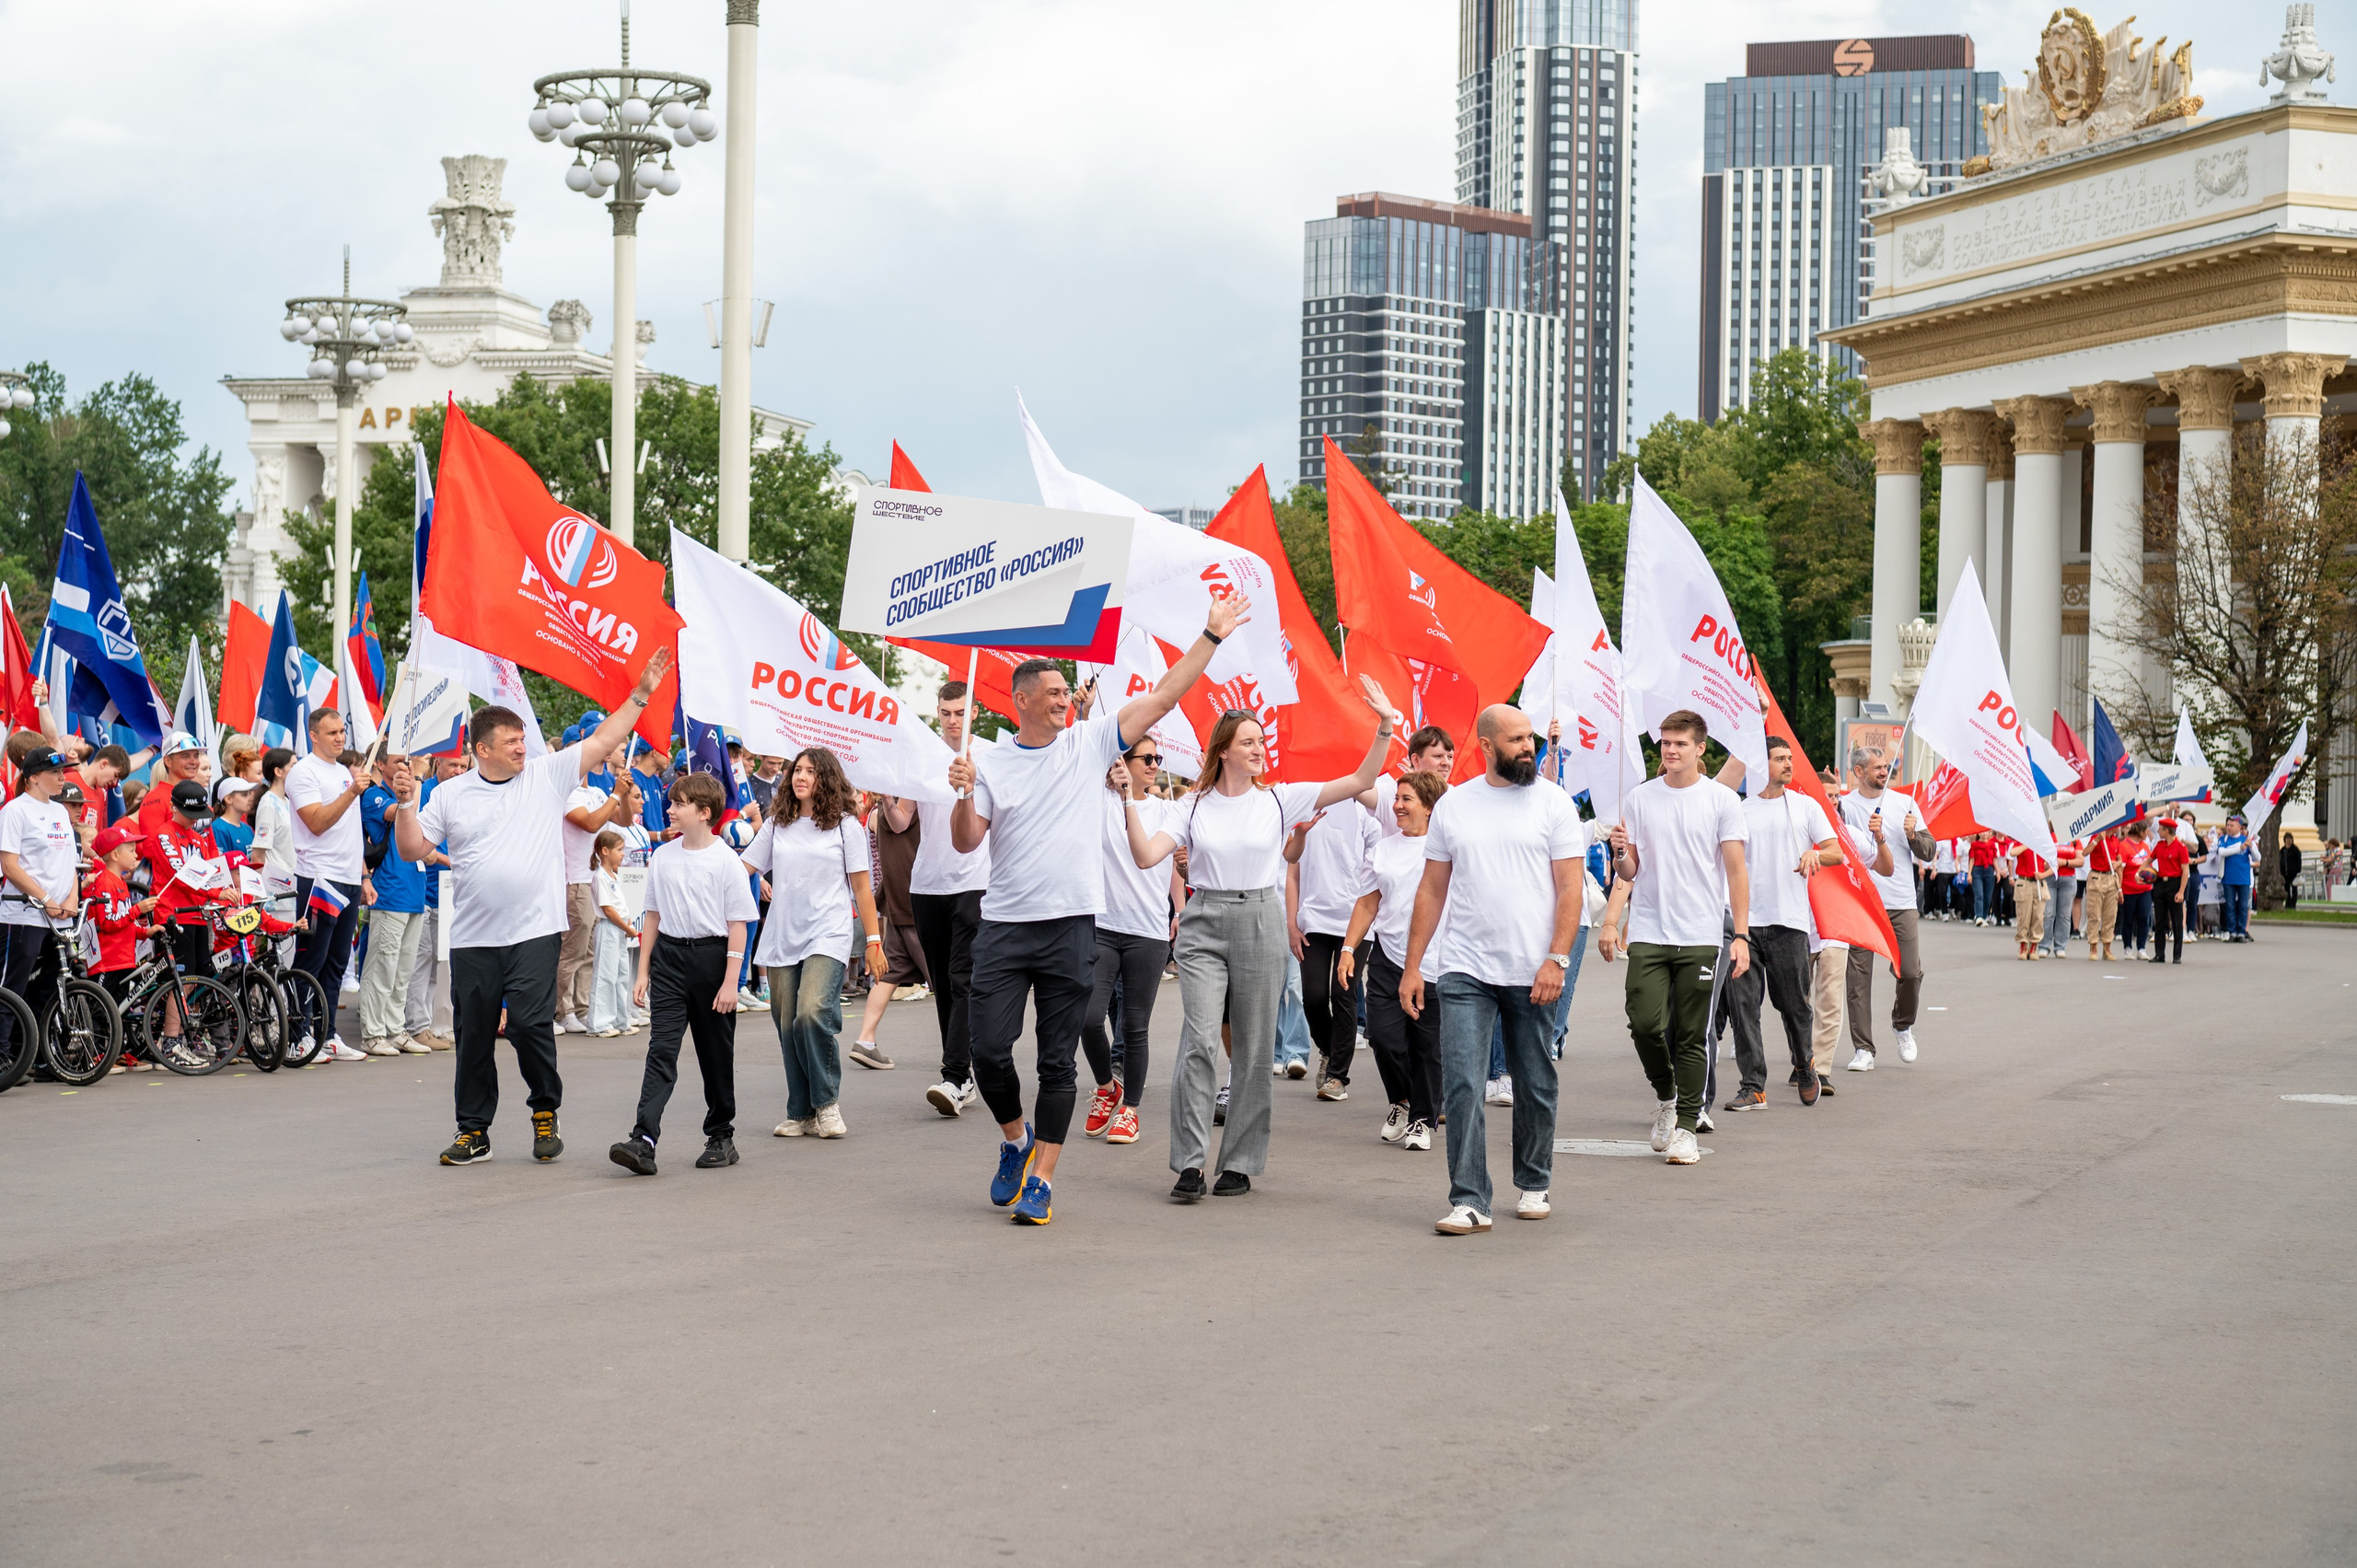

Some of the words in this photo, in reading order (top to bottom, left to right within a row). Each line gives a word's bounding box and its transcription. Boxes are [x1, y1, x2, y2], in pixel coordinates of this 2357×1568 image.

[1984, 168, 2146, 226] РОССИЙСКАЯ
[1953, 215, 2042, 251] СОВЕТСКАЯ
[2049, 179, 2186, 228] ФЕДЕРАТИВНАЯ
[1953, 224, 2087, 270] СОЦИАЛИСТИЧЕСКАЯ
[2096, 200, 2188, 237] РЕСПУБЛИКА
[872, 510, 925, 521] ШЕСТВИЕ
[886, 567, 997, 627] СООБЩЕСТВО
[1000, 536, 1085, 582] «РОССИЯ»
[889, 540, 997, 599] СПОРТИВНОЕ
[520, 554, 639, 656] РОССИЯ
[535, 630, 576, 654] ОСНОВАНО
[1681, 653, 1724, 680] ОБЩЕРОССИЙСКАЯ
[403, 678, 449, 729] ВЛОСИПЕДНЫЙ
[751, 661, 900, 726] РОССИЯ
[1207, 691, 1225, 718] ОСНОВ
[1593, 692, 1620, 719] ОСНОВАНО
[1691, 690, 1724, 714] ОСНОВАНО
[750, 699, 803, 721] ОБЩЕРОССИЙСКАЯ
[804, 717, 849, 733] ОБЩЕСТВЕННАЯ
[850, 728, 892, 744] ОРГАНИЗАЦИЯ
[778, 715, 861, 744] ФИЗКУЛЬТУРНО-СПОРТИВНОЕ
[1968, 718, 2007, 749] ОБЩЕРОССИЙСКАЯ
[1978, 690, 2025, 748] РОС
[775, 727, 813, 750] ОСНОВАНО
[840, 751, 860, 763] ГОДУ
[784, 725, 812, 741] ОБЩЕСТВО
[812, 736, 853, 751] ПРОФСОЮЗОВ
[1865, 736, 1887, 748] ГОРОД
[1973, 749, 2004, 775] ОСНОВАНО
[2008, 777, 2022, 789] 1987
[1983, 748, 2007, 768] ОБЩЕСТВО
[2150, 783, 2176, 798] РЕЗЕРВЫ
[2151, 772, 2180, 790] ТРУДОВЫЕ
[2069, 789, 2115, 839] ЮНАРМИЯ
[235, 912, 255, 929] 115
[217, 952, 229, 964] 115
